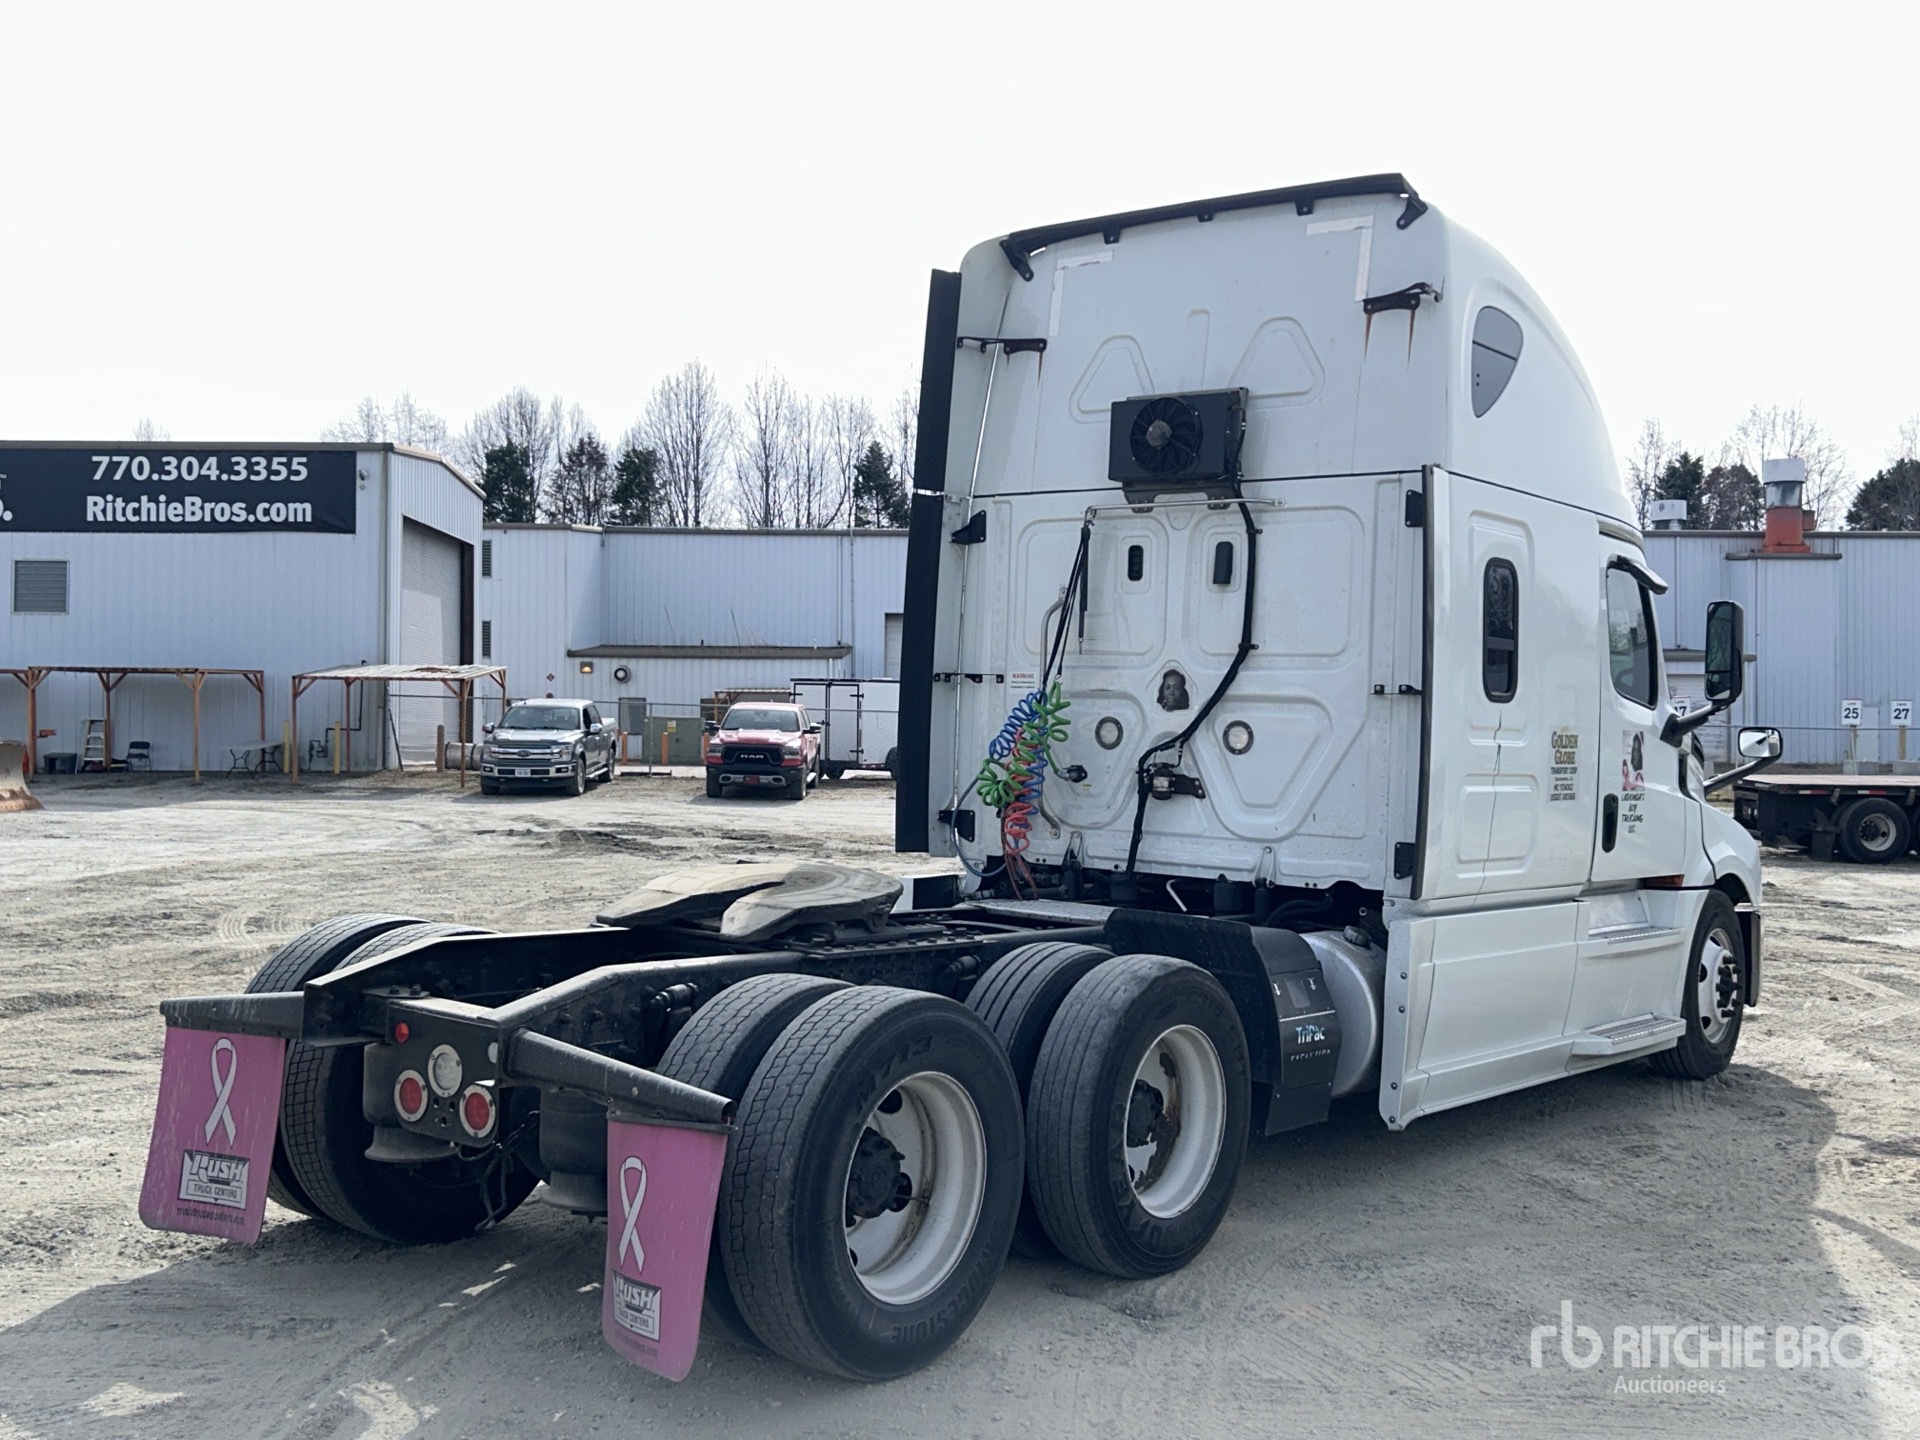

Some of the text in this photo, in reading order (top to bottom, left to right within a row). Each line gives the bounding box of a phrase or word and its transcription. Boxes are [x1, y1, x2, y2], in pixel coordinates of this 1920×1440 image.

[91, 455, 308, 481] 770.304.3355
[86, 494, 312, 522] RitchieBros.com
[1843, 707, 1859, 720] 25
[1893, 708, 1910, 720] 27
[1295, 1025, 1326, 1044] TriPac
[189, 1153, 244, 1184] RUSH
[193, 1183, 238, 1199] TRUCK CENTERS
